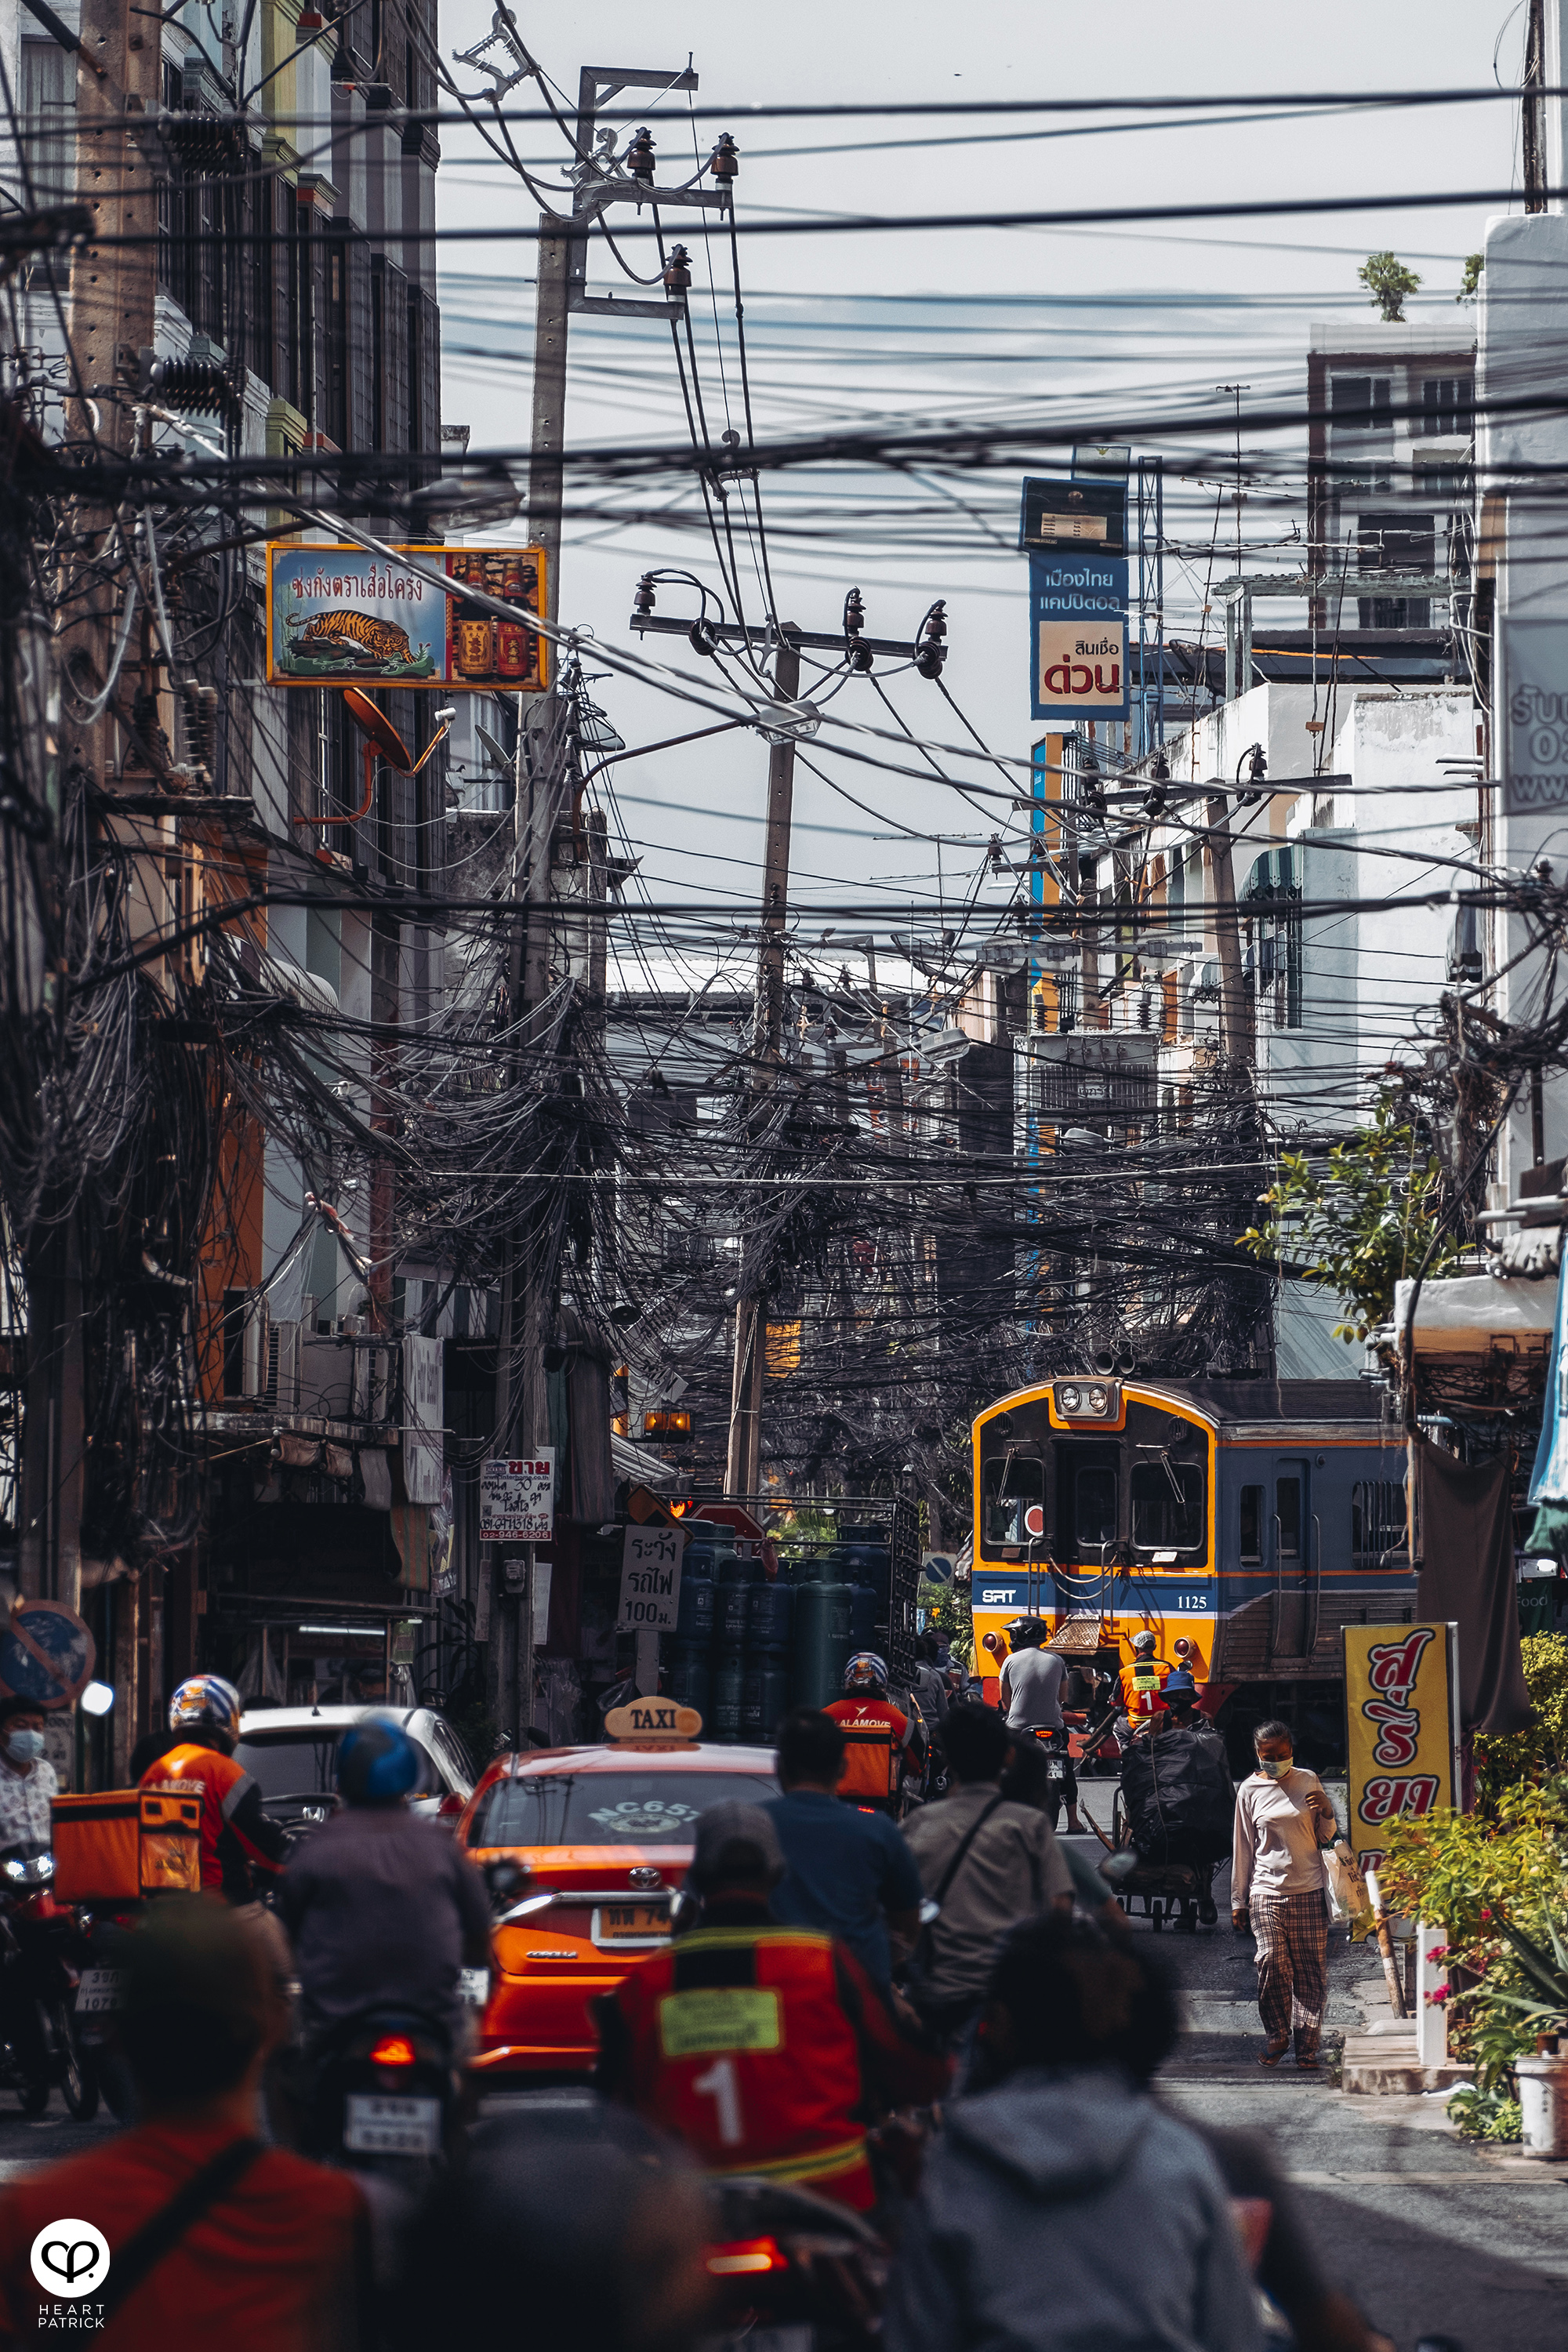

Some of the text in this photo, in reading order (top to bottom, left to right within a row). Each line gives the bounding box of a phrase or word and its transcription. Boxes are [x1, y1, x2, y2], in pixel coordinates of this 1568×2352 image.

[1045, 568, 1113, 587] เมืองไทย
[1040, 593, 1120, 610] แคปปิตอล
[1075, 637, 1120, 655] สินเชื่อ
[1044, 654, 1120, 695] ด่วน
[509, 1461, 550, 1474] ขาย
[631, 1532, 677, 1562] ระวัง
[629, 1566, 673, 1595] รถไฟ
[982, 1590, 1016, 1603] SRT
[1177, 1595, 1207, 1610] 1125
[1141, 1691, 1152, 1710] 1
[630, 1708, 677, 1730] TAXI
[691, 2056, 745, 2147] 1
